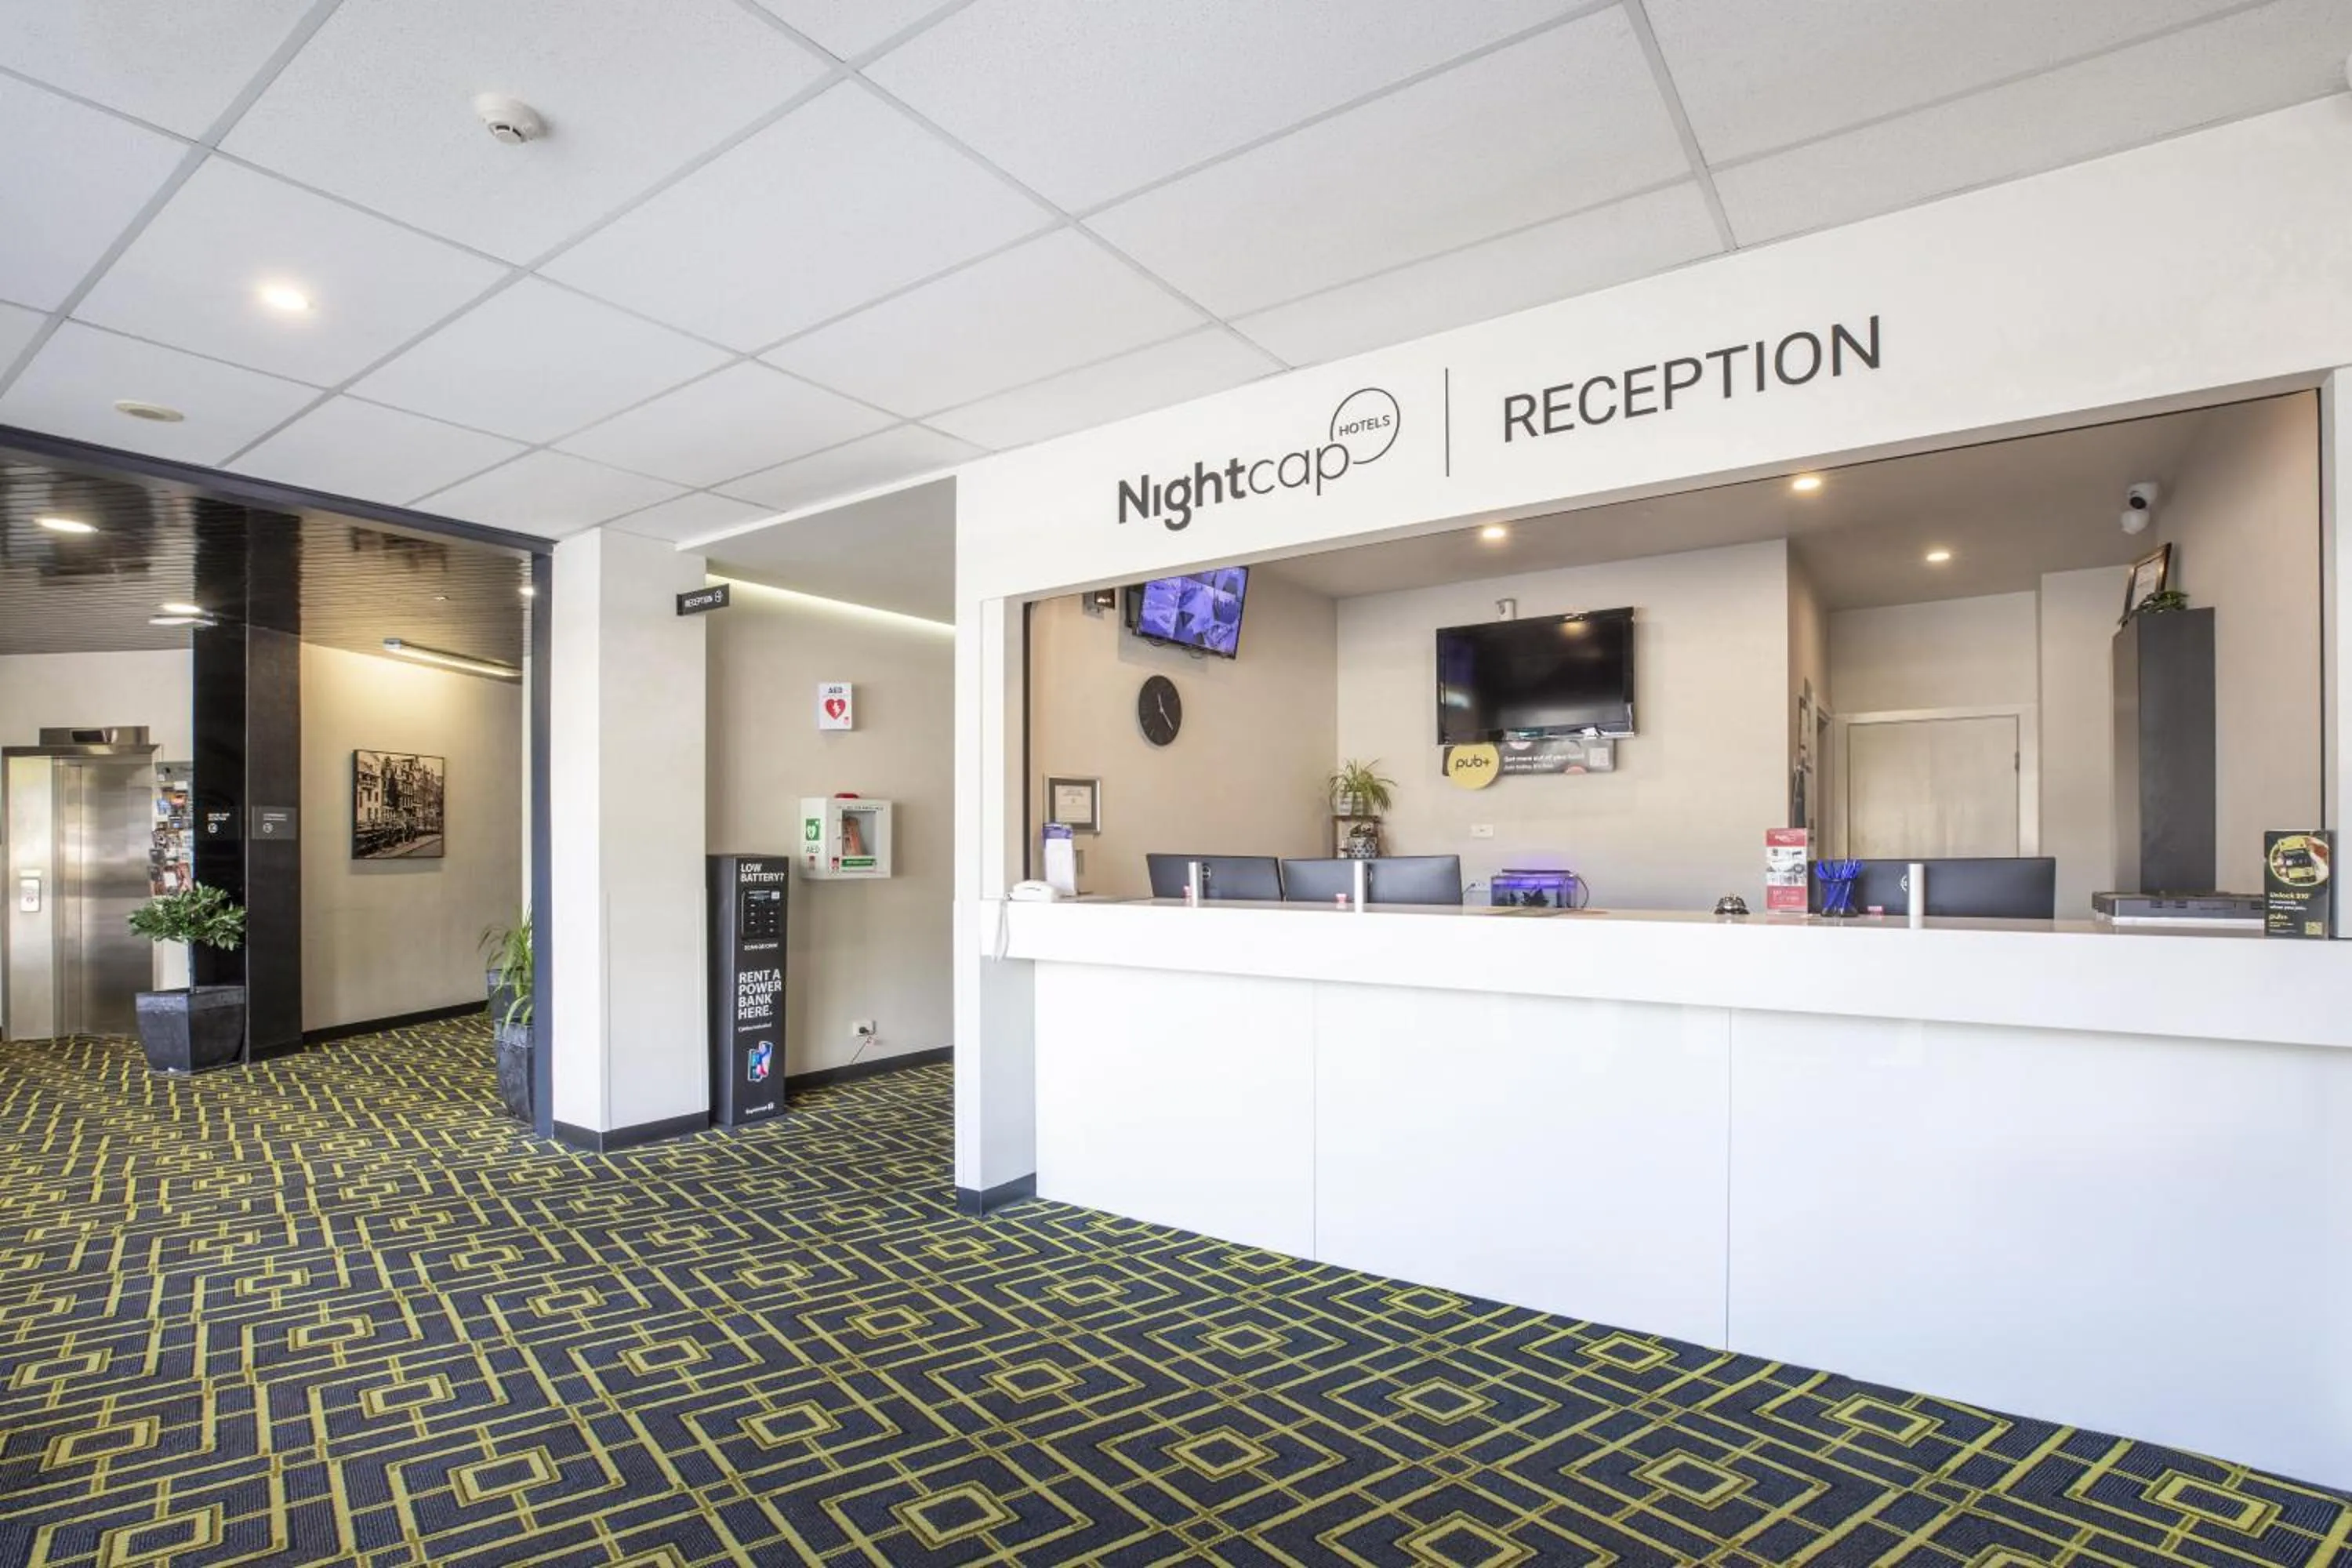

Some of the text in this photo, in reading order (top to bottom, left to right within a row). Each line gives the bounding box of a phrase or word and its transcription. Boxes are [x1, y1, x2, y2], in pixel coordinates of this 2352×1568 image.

[1504, 315, 1880, 443] RECEPTION
[1338, 415, 1391, 437] HOTELS
[1119, 441, 1349, 532] Nightcap
[741, 863, 763, 873] LOW
[740, 873, 785, 882] BATTERY?
[739, 968, 781, 983] RENT A
[738, 981, 782, 995] POWER
[738, 993, 772, 1007] BANK
[738, 1004, 773, 1020] HERE.
